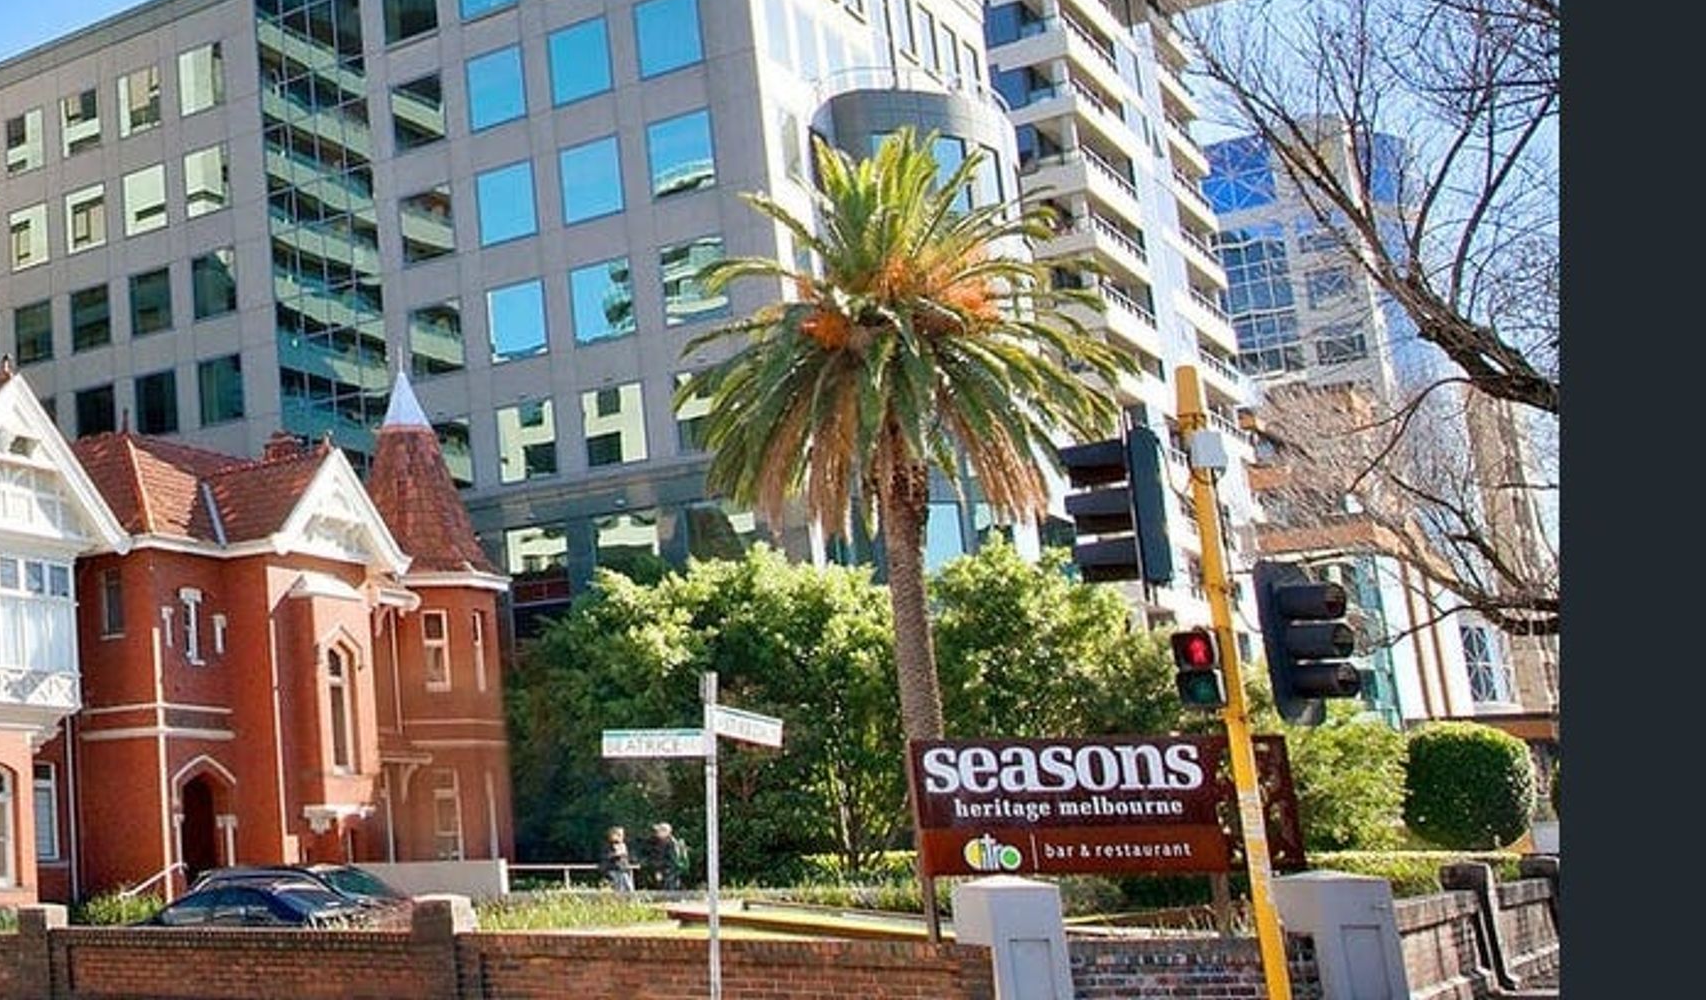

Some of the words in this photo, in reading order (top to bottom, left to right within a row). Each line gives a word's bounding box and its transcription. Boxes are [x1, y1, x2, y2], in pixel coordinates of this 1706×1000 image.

[923, 744, 1203, 793] seasons
[954, 799, 1051, 821] heritage
[1059, 796, 1183, 815] melbourne
[1045, 843, 1074, 858] bar
[1079, 845, 1090, 857] &
[1095, 842, 1192, 858] restaurant
